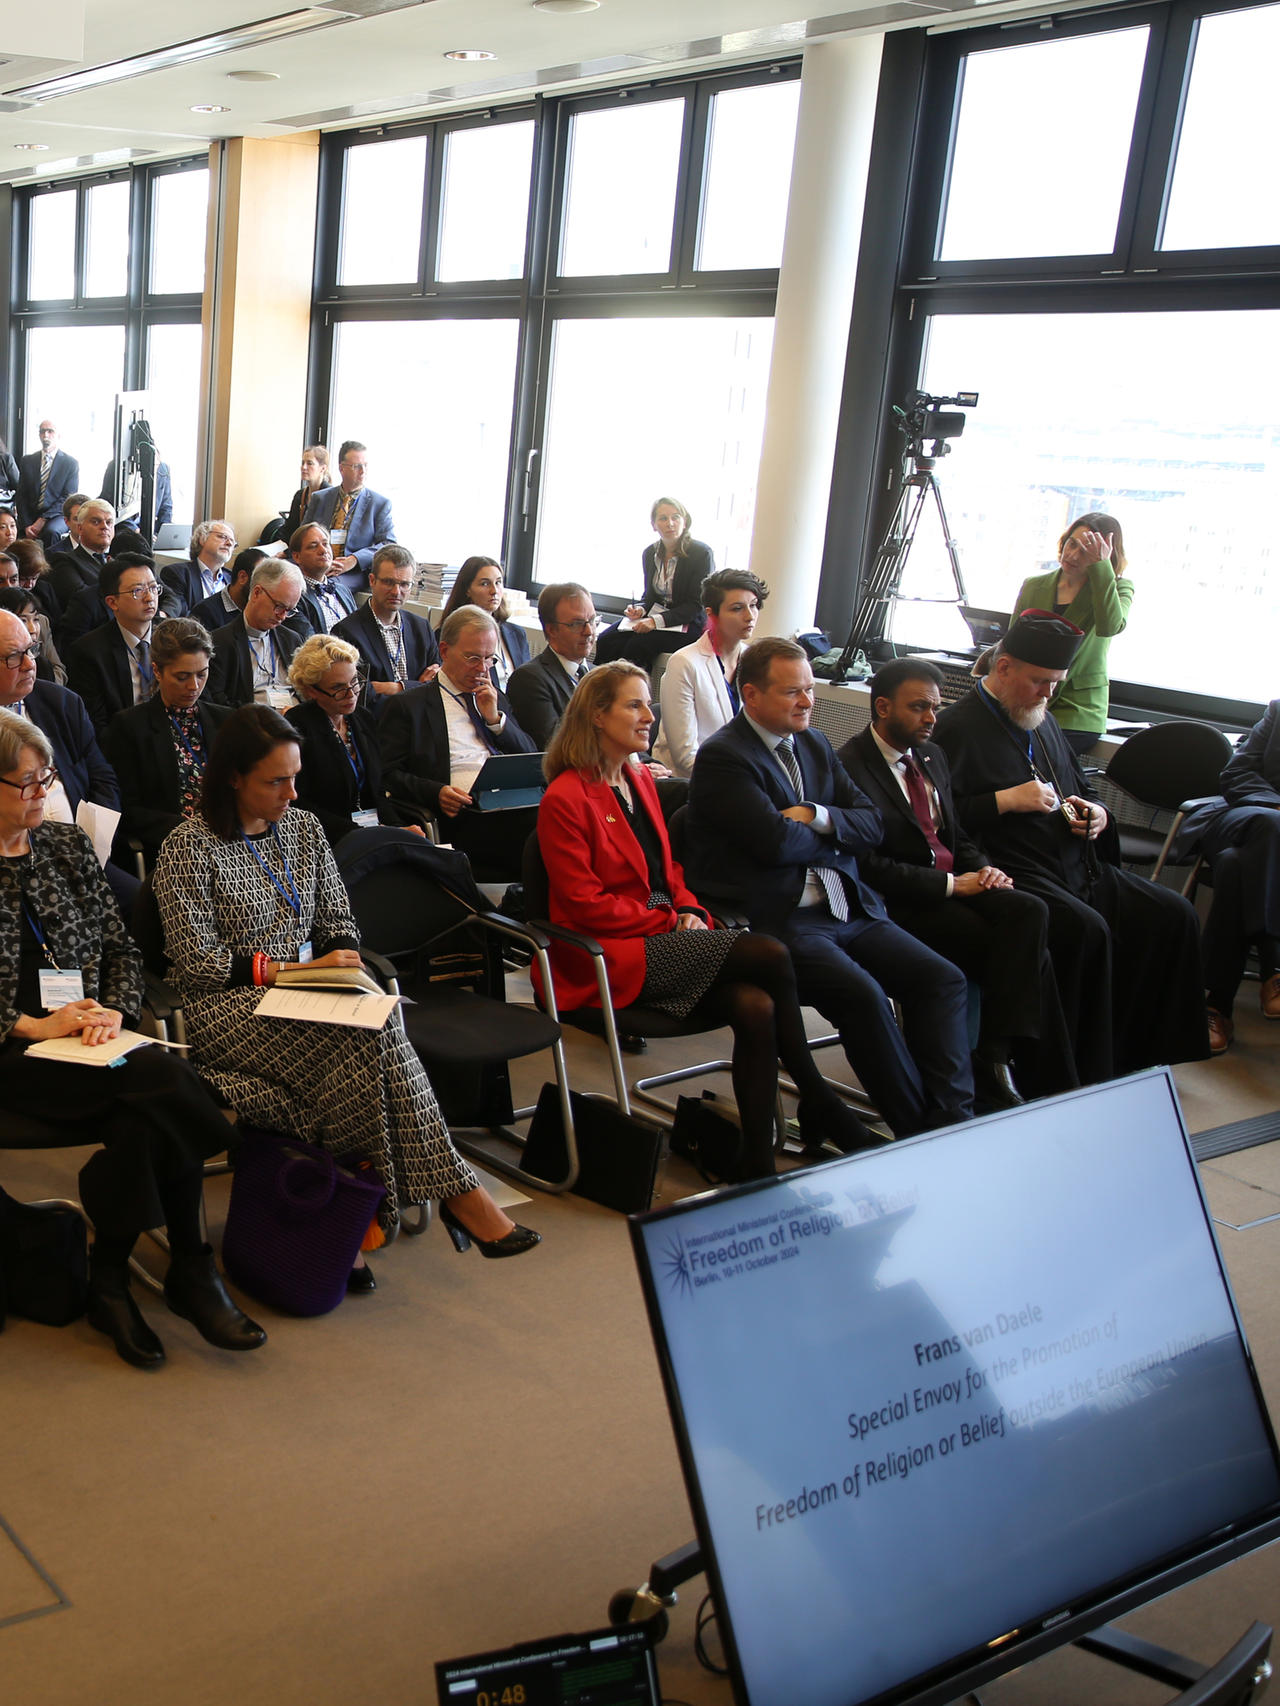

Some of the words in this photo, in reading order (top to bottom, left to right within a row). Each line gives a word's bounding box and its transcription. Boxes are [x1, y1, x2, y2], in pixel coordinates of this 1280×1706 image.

[684, 1224, 737, 1248] International
[737, 1212, 778, 1232] Ministerial
[688, 1237, 764, 1273] Freedom
[769, 1225, 785, 1247] of
[789, 1208, 854, 1242] Religion
[694, 1272, 721, 1288] Berlin,
[722, 1263, 744, 1278] 10-11
[745, 1254, 777, 1271] October
[780, 1245, 799, 1260] 2024
[913, 1335, 961, 1366] Frans
[963, 1323, 995, 1348] van
[996, 1303, 1044, 1335] Daele
[848, 1393, 909, 1440] Special
[913, 1379, 961, 1413] Envoy
[965, 1367, 988, 1399] for
[993, 1355, 1019, 1382] the
[1022, 1324, 1101, 1370] Promotion
[1104, 1310, 1119, 1341] of
[756, 1482, 837, 1531] Freedom
[842, 1464, 861, 1498] of
[865, 1442, 935, 1486] Religion
[938, 1433, 956, 1456] or
[960, 1406, 1005, 1446] Belief
[1009, 1384, 1065, 1426] outside
[1068, 1375, 1093, 1402] the
[1096, 1349, 1165, 1391] European
[1165, 1332, 1208, 1361] Union
[477, 1685, 526, 1706] 0:48
